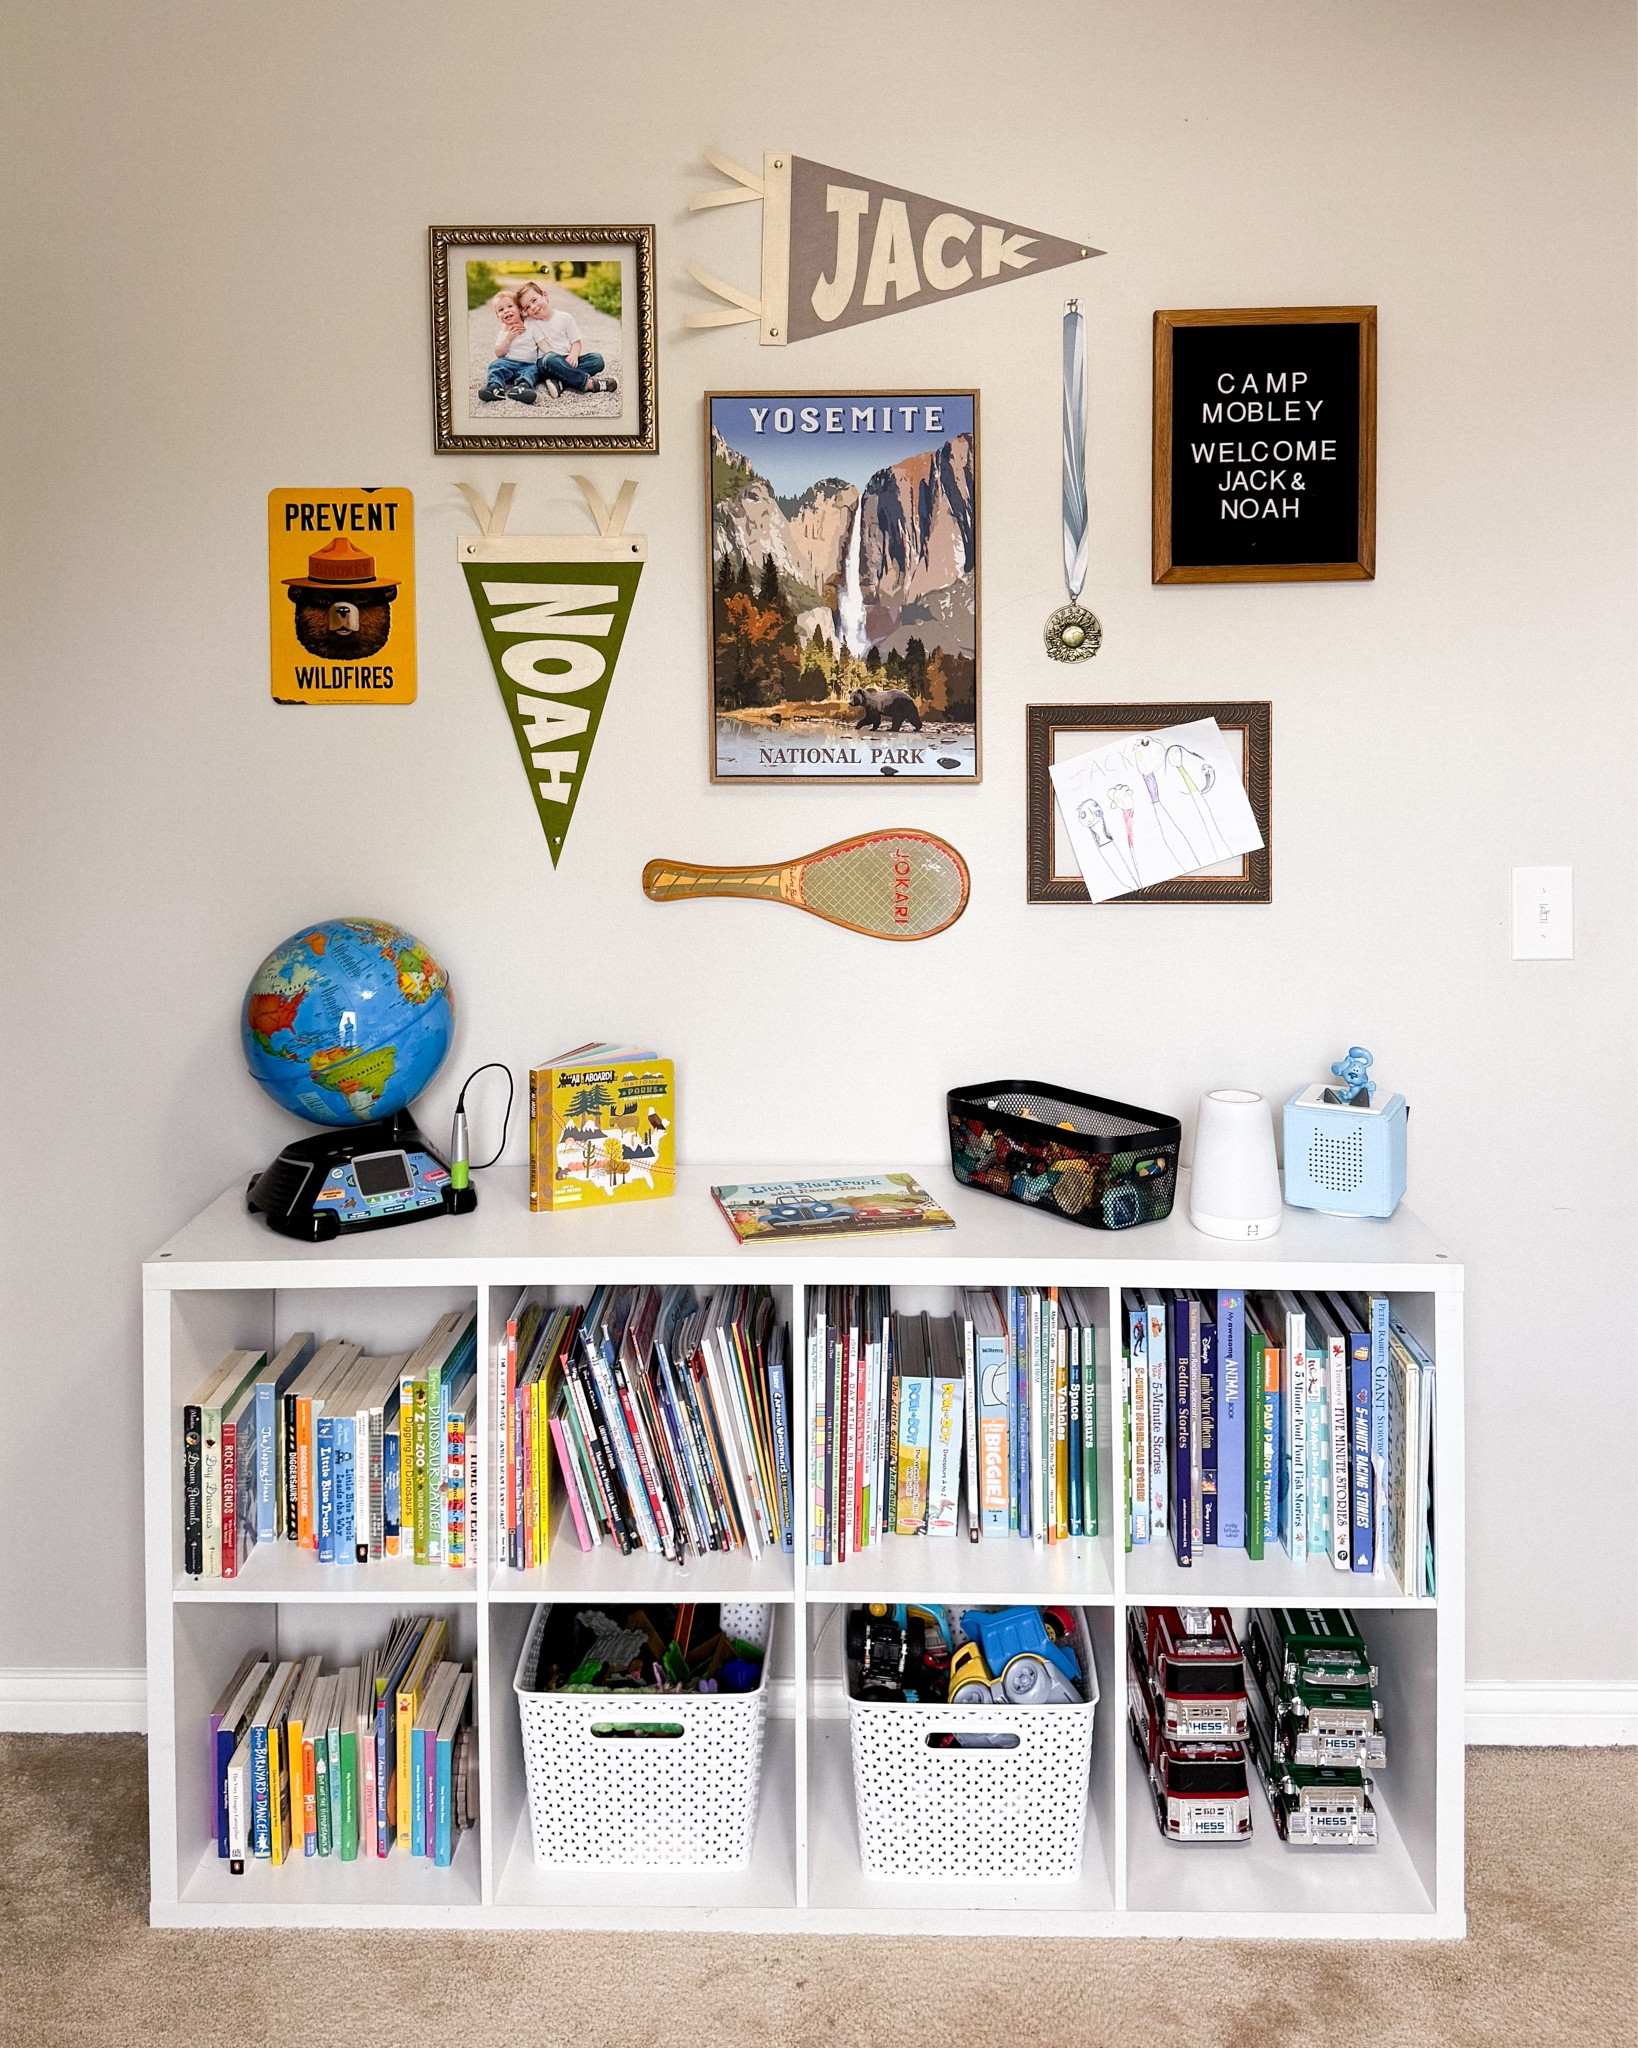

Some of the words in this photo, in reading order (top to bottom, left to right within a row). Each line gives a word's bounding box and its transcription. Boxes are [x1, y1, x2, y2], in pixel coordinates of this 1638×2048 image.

[811, 184, 1039, 324] JACK
[1218, 372, 1308, 394] CAMP
[749, 406, 944, 433] YOSEMITE
[1202, 400, 1323, 423] MOBLEY
[1191, 440, 1337, 463] WELCOME
[285, 503, 398, 531] PREVENT
[1221, 498, 1299, 519] NOAH
[295, 666, 394, 689] WILDFIRES
[481, 581, 619, 805] NOAH
[759, 748, 862, 764] NATIONAL
[871, 748, 925, 764] PARK
[894, 847, 910, 923] JOKARI
[748, 1185, 793, 1195] Little
[794, 1182, 828, 1190] Blue
[828, 1179, 882, 1187] Truck
[1226, 1311, 1234, 1322] My
[1377, 1303, 1386, 1328] PETER
[1201, 1336, 1211, 1364] Disney's
[1225, 1322, 1234, 1359] awesome
[1377, 1330, 1386, 1364] RABBIT'S
[1135, 1367, 1144, 1410] 5-MINUTE
[1178, 1357, 1189, 1405] Bedtime
[1201, 1373, 1213, 1395] Family
[1225, 1359, 1238, 1402] ANIMAL
[1294, 1371, 1305, 1416] 5-Minute
[1334, 1369, 1343, 1399] Treasury
[1375, 1366, 1388, 1412] GIANT
[415, 1412, 425, 1422] Z
[773, 1392, 785, 1426] CAPTAIN
[890, 1400, 899, 1427] Little
[1057, 1385, 1067, 1441] Vehicles
[1070, 1383, 1081, 1420] Space
[1084, 1383, 1094, 1448] Dinosaurs
[1152, 1382, 1164, 1433] 5-Minute
[1201, 1396, 1213, 1415] Story
[1263, 1404, 1272, 1430] PAW
[261, 1427, 271, 1446] The
[403, 1416, 414, 1453] Digging
[1179, 1408, 1189, 1449] Stories
[1202, 1417, 1213, 1449] Collection
[1334, 1408, 1345, 1433] FIVE
[1355, 1406, 1370, 1452] 5-MINUTE
[416, 1432, 425, 1442] for
[429, 1405, 441, 1478] DINOSAUR
[776, 1427, 788, 1473] UNDERPANTS
[889, 1429, 898, 1461] Engine
[1050, 1444, 1054, 1452] Do
[1135, 1412, 1144, 1465] SPIDER-MAN
[1294, 1419, 1306, 1467] Pout-Pout
[187, 1452, 199, 1485] Dream
[204, 1455, 217, 1478] Day
[224, 1445, 235, 1469] ROCK
[260, 1446, 271, 1477] Napping
[299, 1445, 308, 1488] DIGGERSAURS
[321, 1447, 331, 1477] Little
[405, 1454, 414, 1469] for
[416, 1443, 425, 1467] ZOO
[984, 1433, 1006, 1505] BIGGIE!
[1153, 1436, 1164, 1475] Stories
[1263, 1434, 1274, 1475] PATROL
[1335, 1435, 1347, 1474] MINUTE
[288, 1452, 297, 1502] DIGGERSAURS
[336, 1474, 344, 1499] Leads
[345, 1468, 353, 1491] Little
[595, 1451, 604, 1469] There's
[603, 1478, 611, 1492] Place
[607, 1493, 615, 1504] Like
[611, 1505, 620, 1521] Space!
[1136, 1467, 1145, 1502] STORIES
[1294, 1470, 1305, 1490] Fish
[1356, 1454, 1370, 1489] RACING
[205, 1482, 218, 1529] Dreamers
[224, 1473, 235, 1514] LEGENDS
[263, 1477, 271, 1502] House
[322, 1480, 331, 1504] Blue
[345, 1493, 353, 1512] Blue
[405, 1470, 415, 1516] Dinosaurs
[889, 1489, 897, 1515] Could
[1263, 1479, 1272, 1523] TREASURY
[1336, 1475, 1348, 1527] STORIES
[187, 1486, 200, 1526] Animals
[322, 1503, 332, 1537] Truck
[430, 1482, 441, 1534] DANCE!
[1294, 1492, 1304, 1527] Stories
[1356, 1491, 1371, 1528] STORIES
[335, 1517, 344, 1537] Way
[1135, 1515, 1145, 1539] MARVEL
[1193, 1723, 1222, 1731] HESS
[1326, 1739, 1356, 1748] HESS
[255, 1748, 266, 1793] BARNYARD
[318, 1774, 326, 1785] BUT
[378, 1759, 384, 1770] Am
[319, 1786, 327, 1797] NOT
[256, 1799, 267, 1833] DANCE!
[1195, 1822, 1225, 1830] HESS
[1317, 1817, 1347, 1826] HESS
